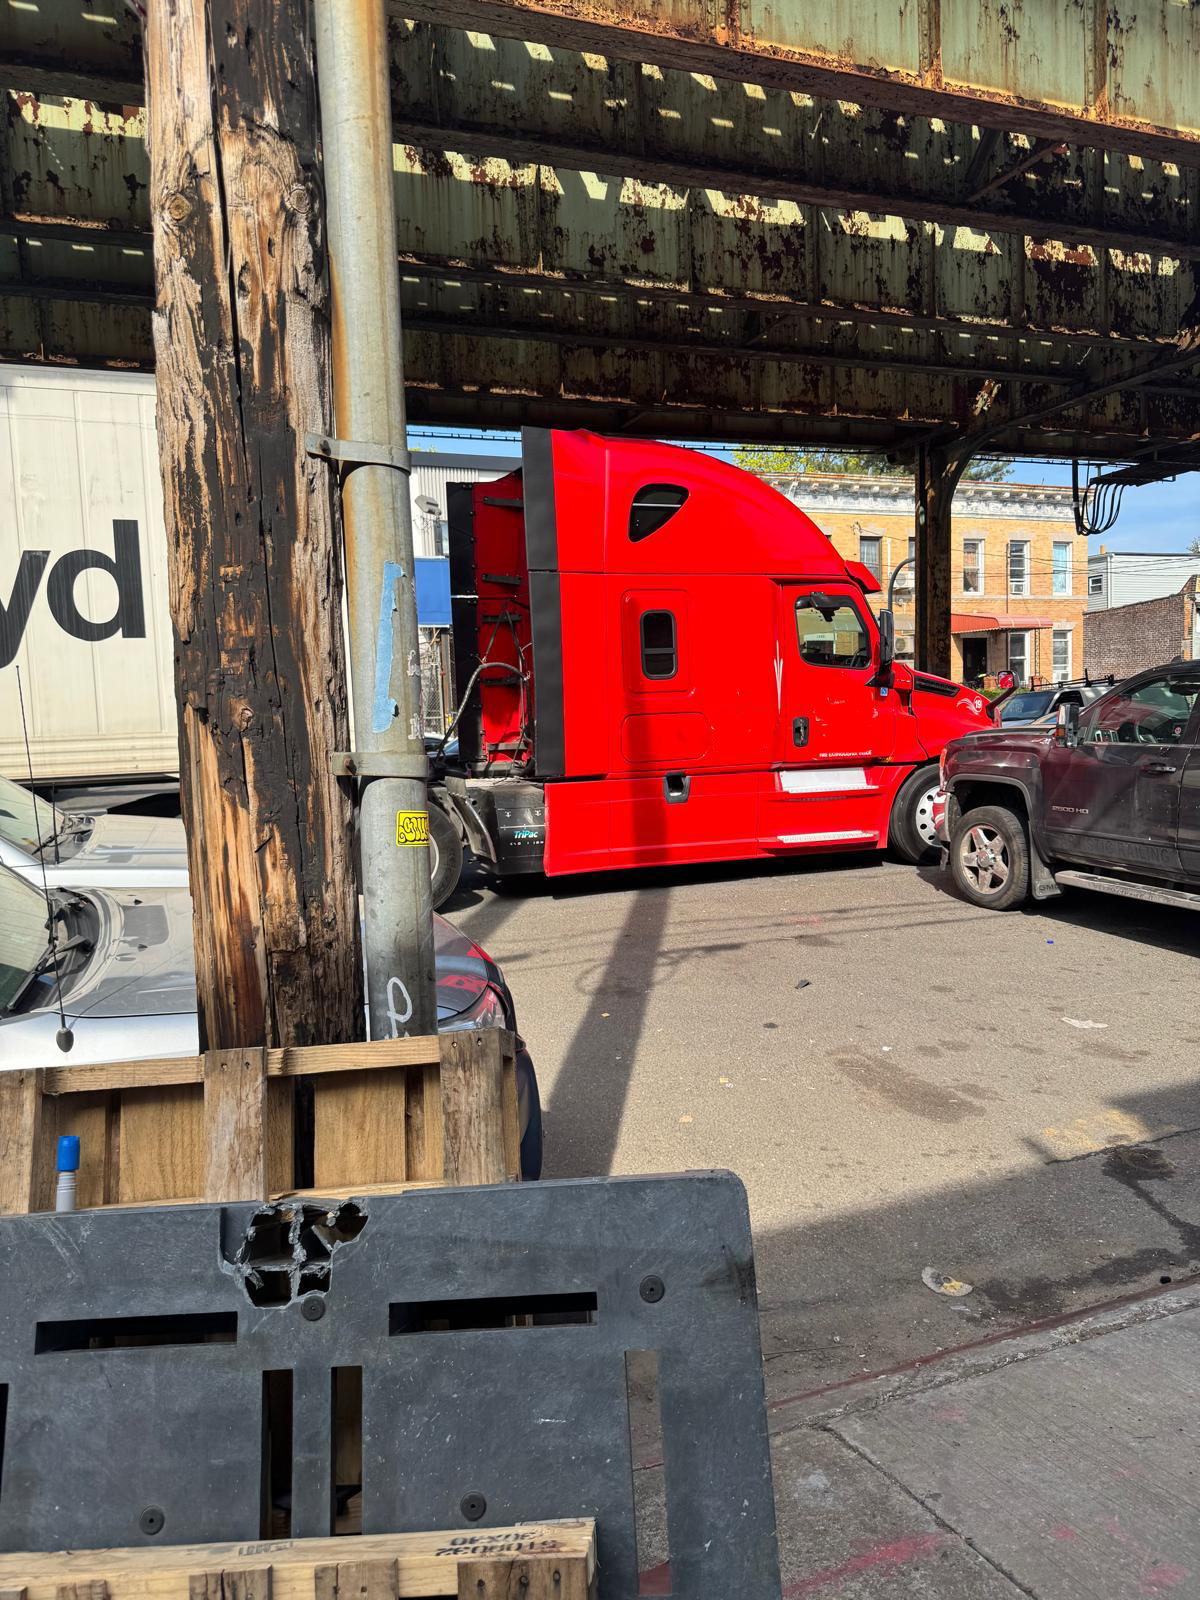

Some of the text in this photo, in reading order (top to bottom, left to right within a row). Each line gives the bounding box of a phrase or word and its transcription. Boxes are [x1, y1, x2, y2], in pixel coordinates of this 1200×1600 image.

[974, 699, 983, 709] 19
[1051, 805, 1074, 813] 2500
[514, 830, 539, 839] TriPac
